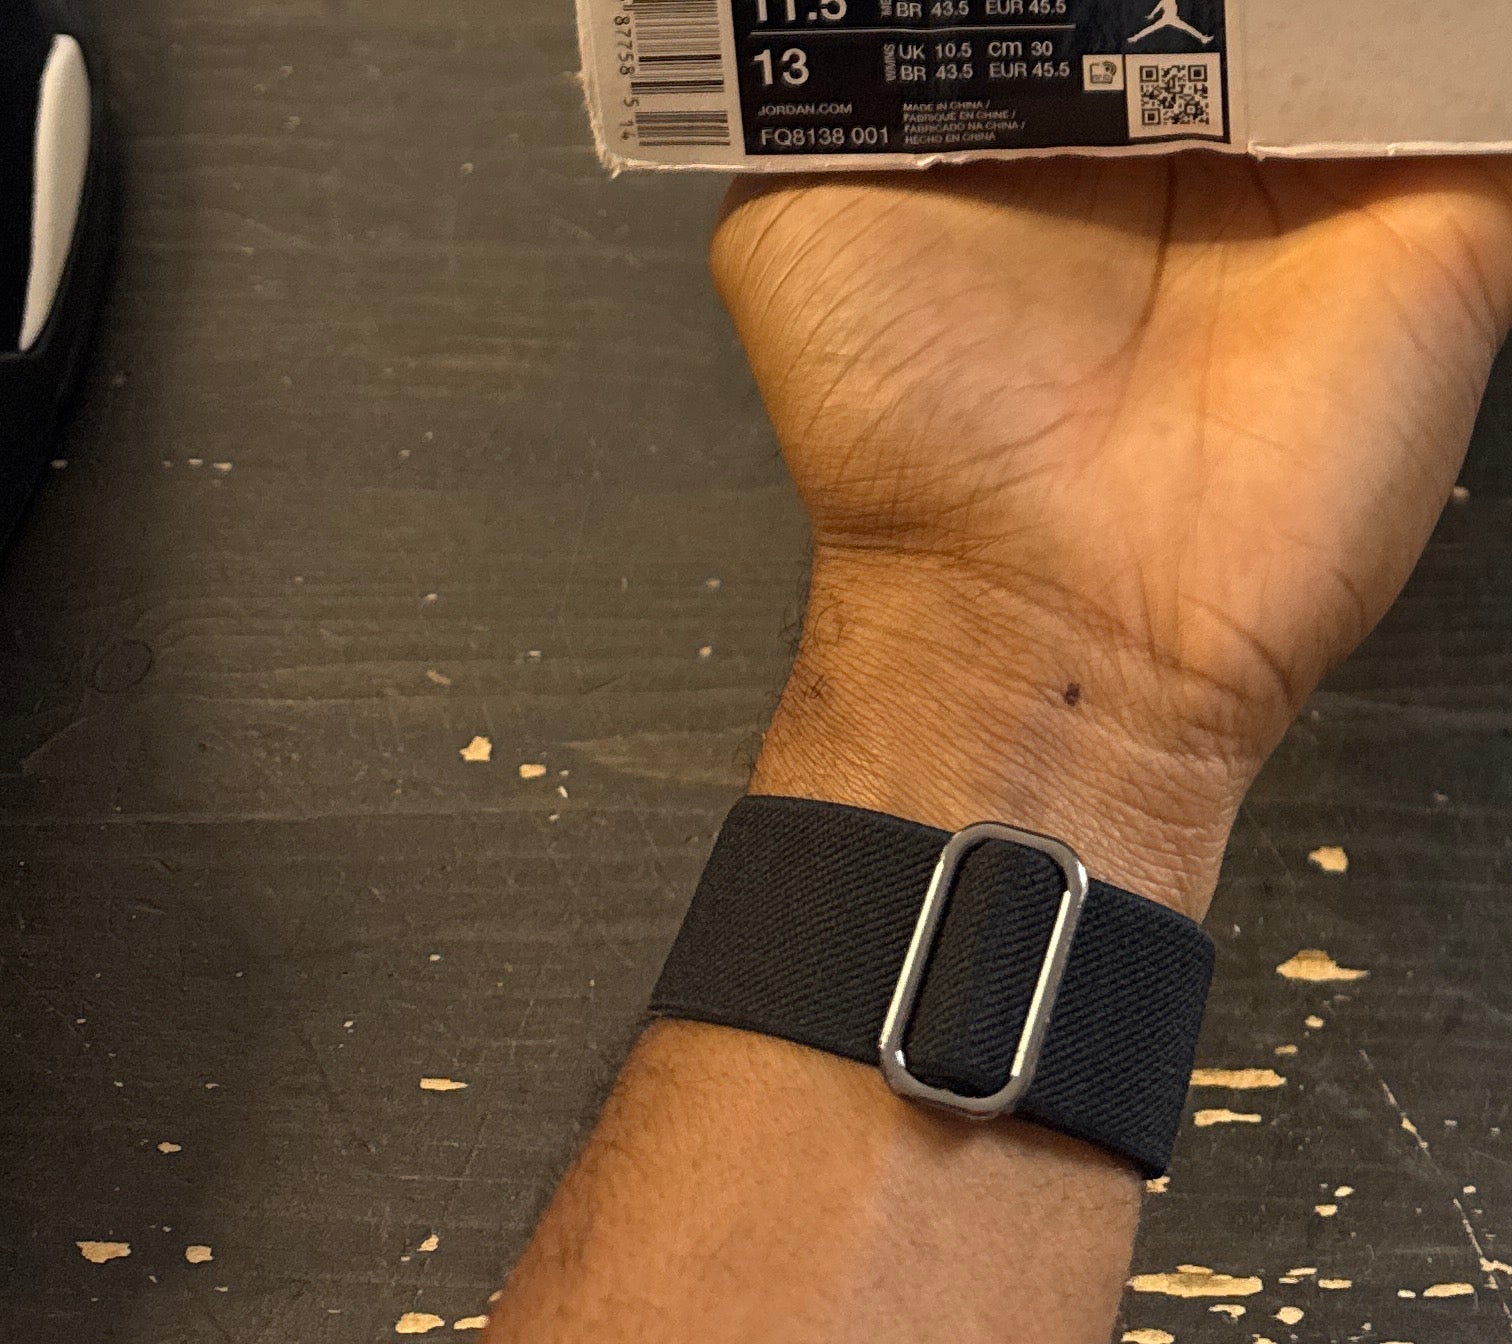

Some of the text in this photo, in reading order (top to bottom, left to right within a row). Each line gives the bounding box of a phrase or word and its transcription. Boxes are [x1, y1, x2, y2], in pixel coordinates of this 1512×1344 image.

[896, 2, 922, 18] BR
[931, 0, 969, 17] 43.5
[985, 0, 1023, 15] EUR
[614, 15, 636, 76] 87758
[900, 44, 926, 61] UK
[935, 42, 972, 59] 10.5
[1031, 41, 1053, 57] 30
[753, 48, 810, 86] 13
[901, 61, 1070, 82] BR 43.5 EUR 45.5
[758, 103, 853, 116] JORDAN.COM
[761, 126, 889, 146] FQ8138 001
